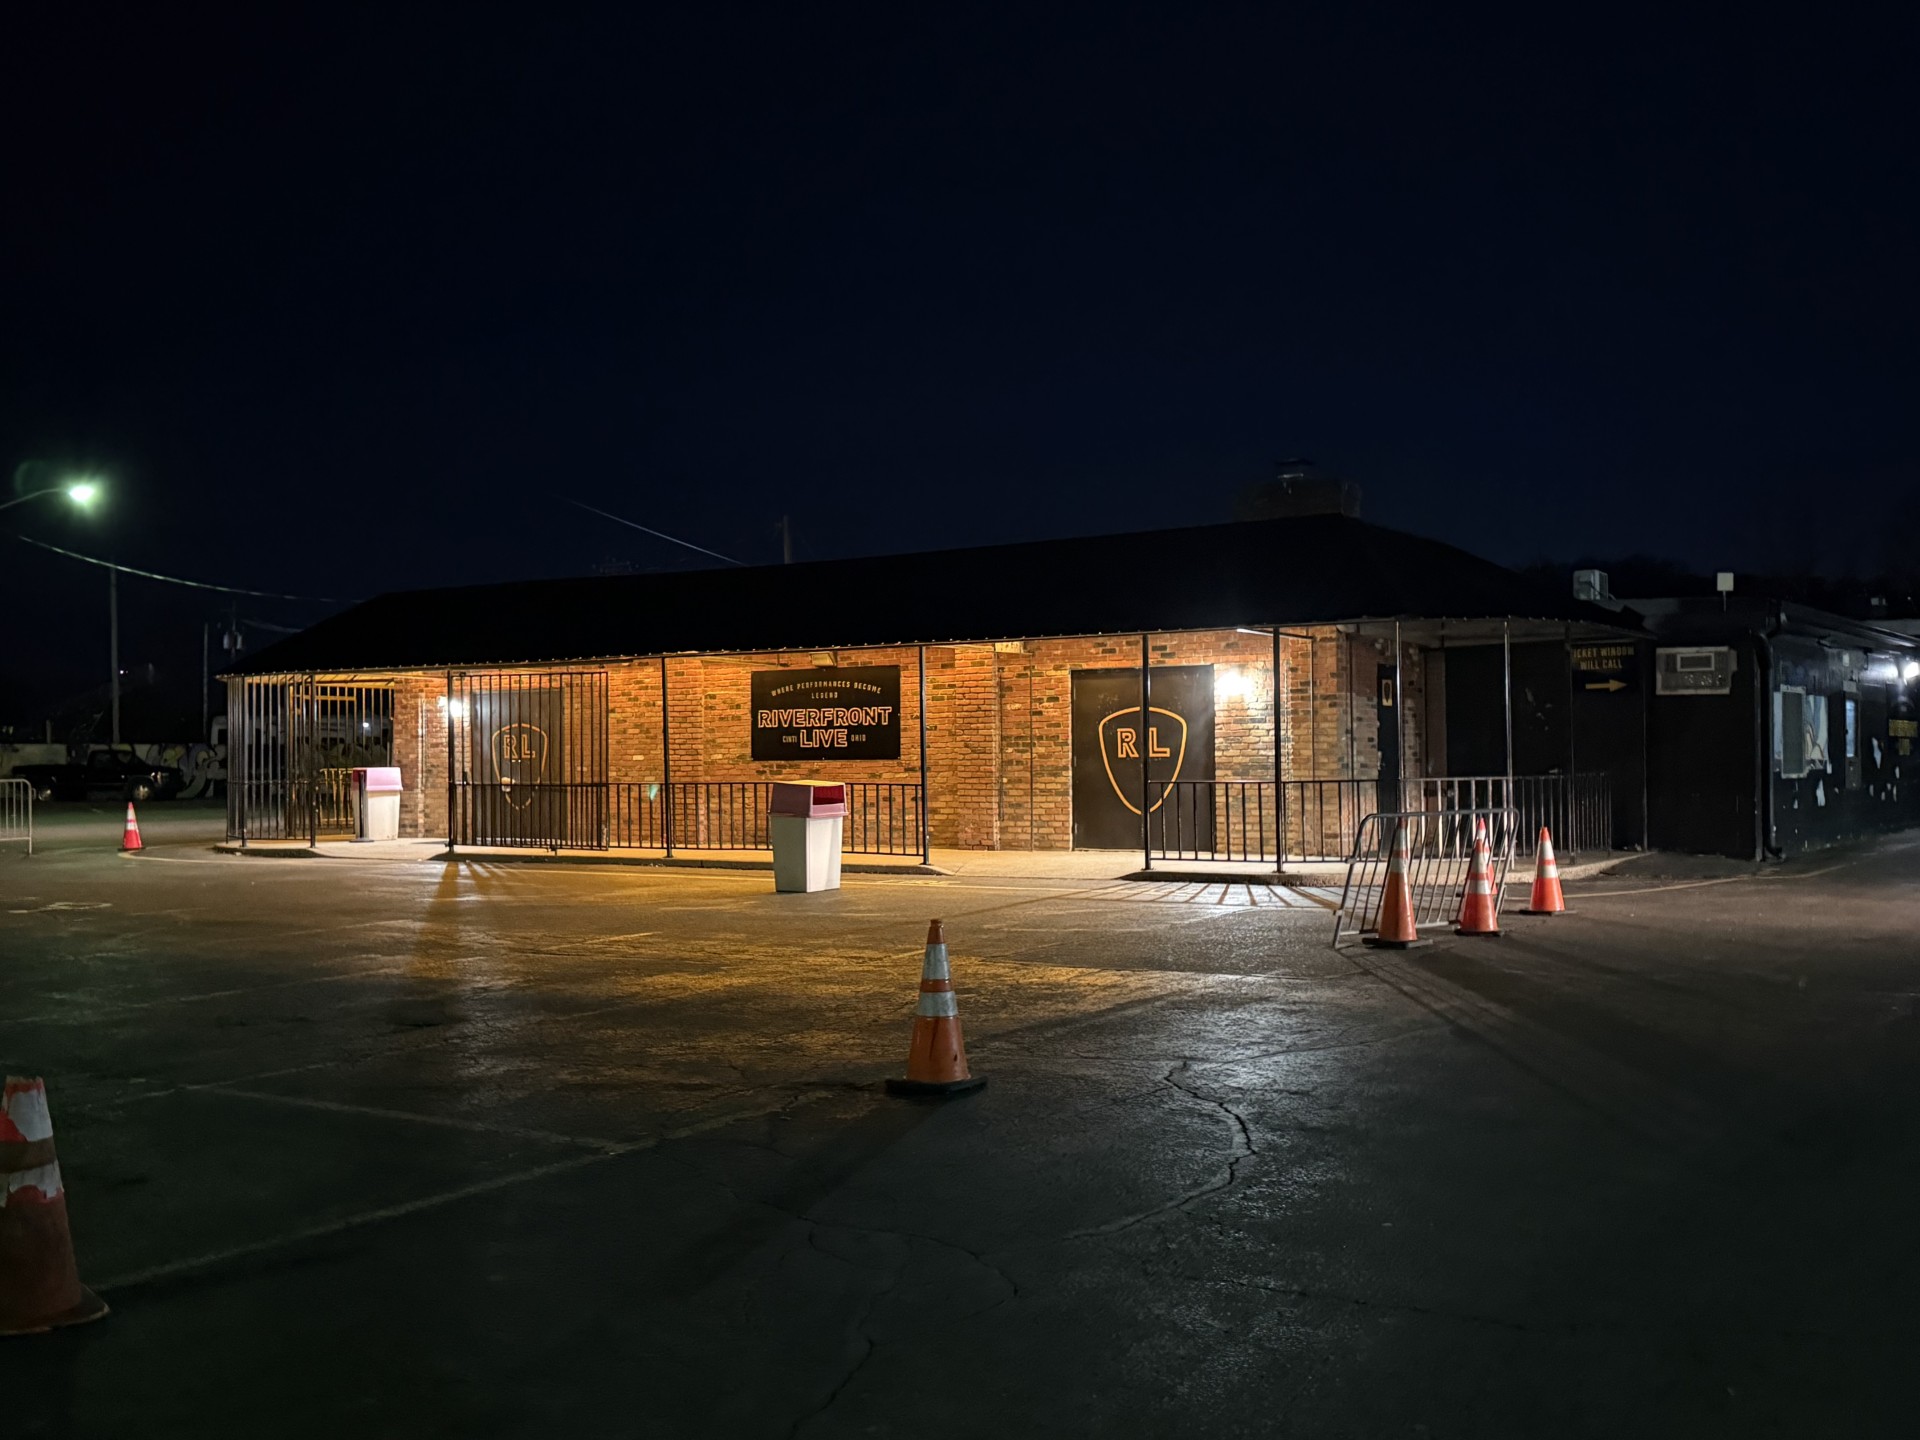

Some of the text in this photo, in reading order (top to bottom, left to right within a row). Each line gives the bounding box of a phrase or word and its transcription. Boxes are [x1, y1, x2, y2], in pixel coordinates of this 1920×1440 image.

[1571, 648, 1597, 658] ICKET
[1580, 658, 1623, 670] WILL CALL
[771, 681, 882, 696] WHERE PERFORMANCES BECOME
[811, 691, 838, 699] LEGEND
[758, 706, 892, 728] RIVERFRONT
[800, 728, 848, 748] LIVE
[850, 734, 866, 742] OHIO
